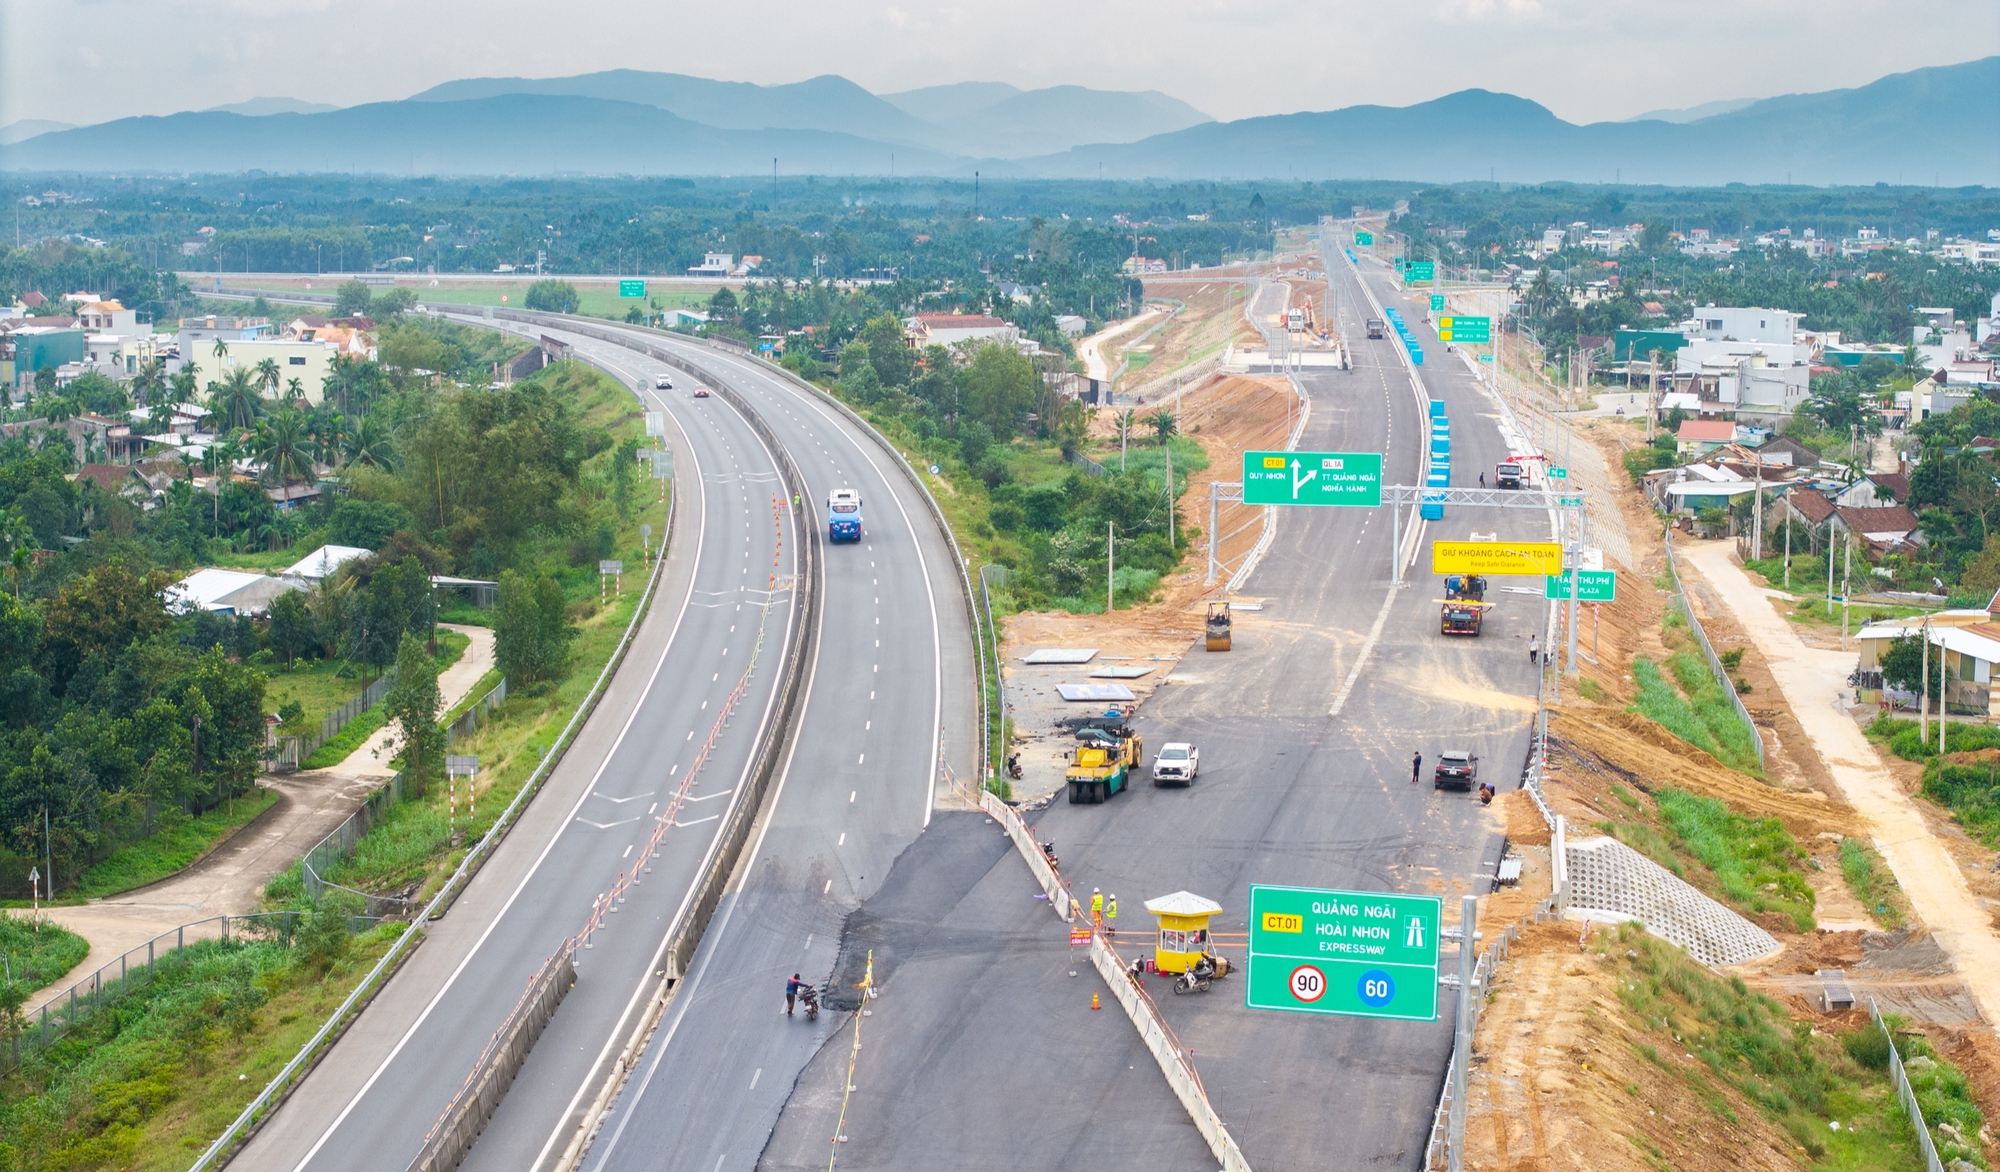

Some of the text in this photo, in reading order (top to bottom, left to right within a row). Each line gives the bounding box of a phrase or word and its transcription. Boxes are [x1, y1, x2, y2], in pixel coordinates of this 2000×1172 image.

[1359, 473, 1376, 481] NGÃI
[1322, 483, 1367, 492] NGHĨA HÀNH
[1532, 548, 1554, 558] TOÀN
[1578, 577, 1594, 585] THU
[1596, 576, 1610, 585] PHÍ
[1311, 899, 1396, 919] QUẢNG NGÃI
[1268, 916, 1297, 930] CT.01
[1315, 921, 1390, 940] HOÀI NHƠN
[1319, 942, 1386, 955] EXPRESSWAY
[1297, 975, 1318, 992] 90
[1365, 979, 1388, 998] 60
